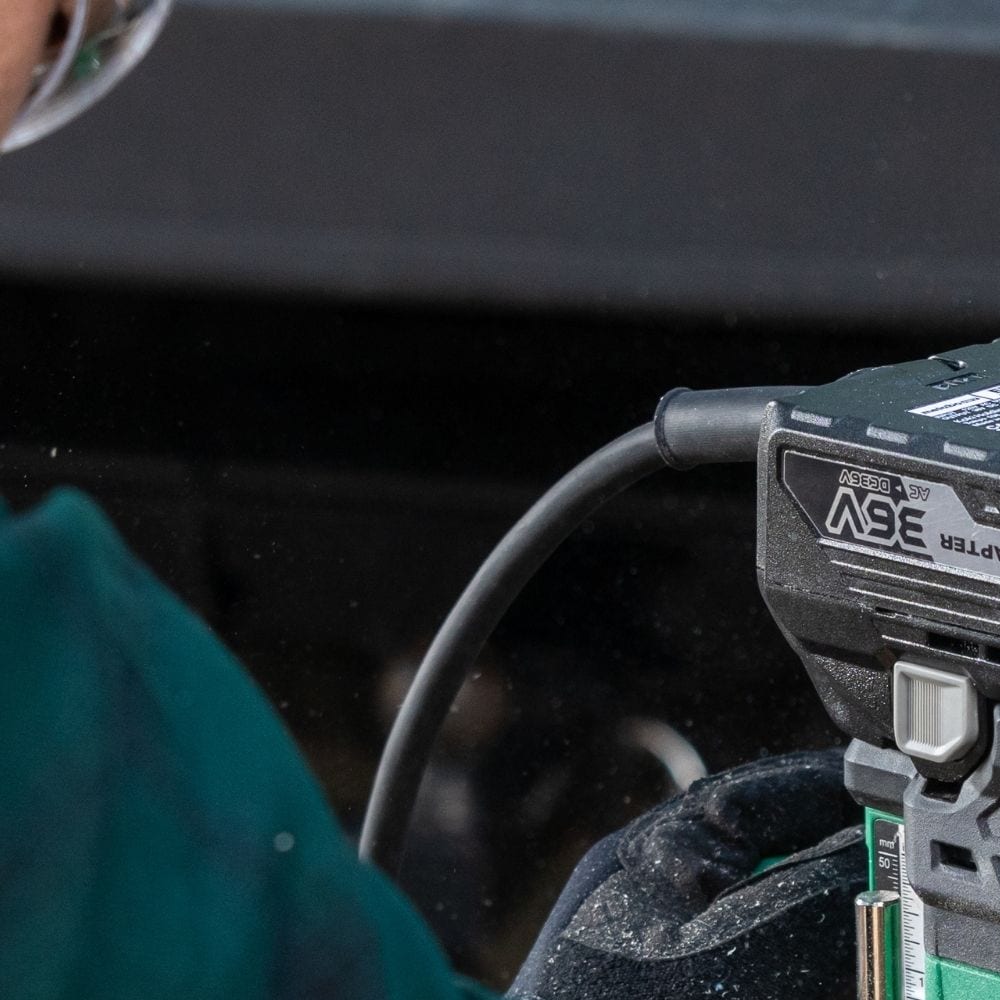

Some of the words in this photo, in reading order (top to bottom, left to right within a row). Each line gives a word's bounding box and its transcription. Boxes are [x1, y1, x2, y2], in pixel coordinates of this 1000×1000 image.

[909, 484, 931, 501] AC
[825, 486, 928, 548] 36V
[879, 838, 895, 849] mm
[878, 856, 891, 869] 50
